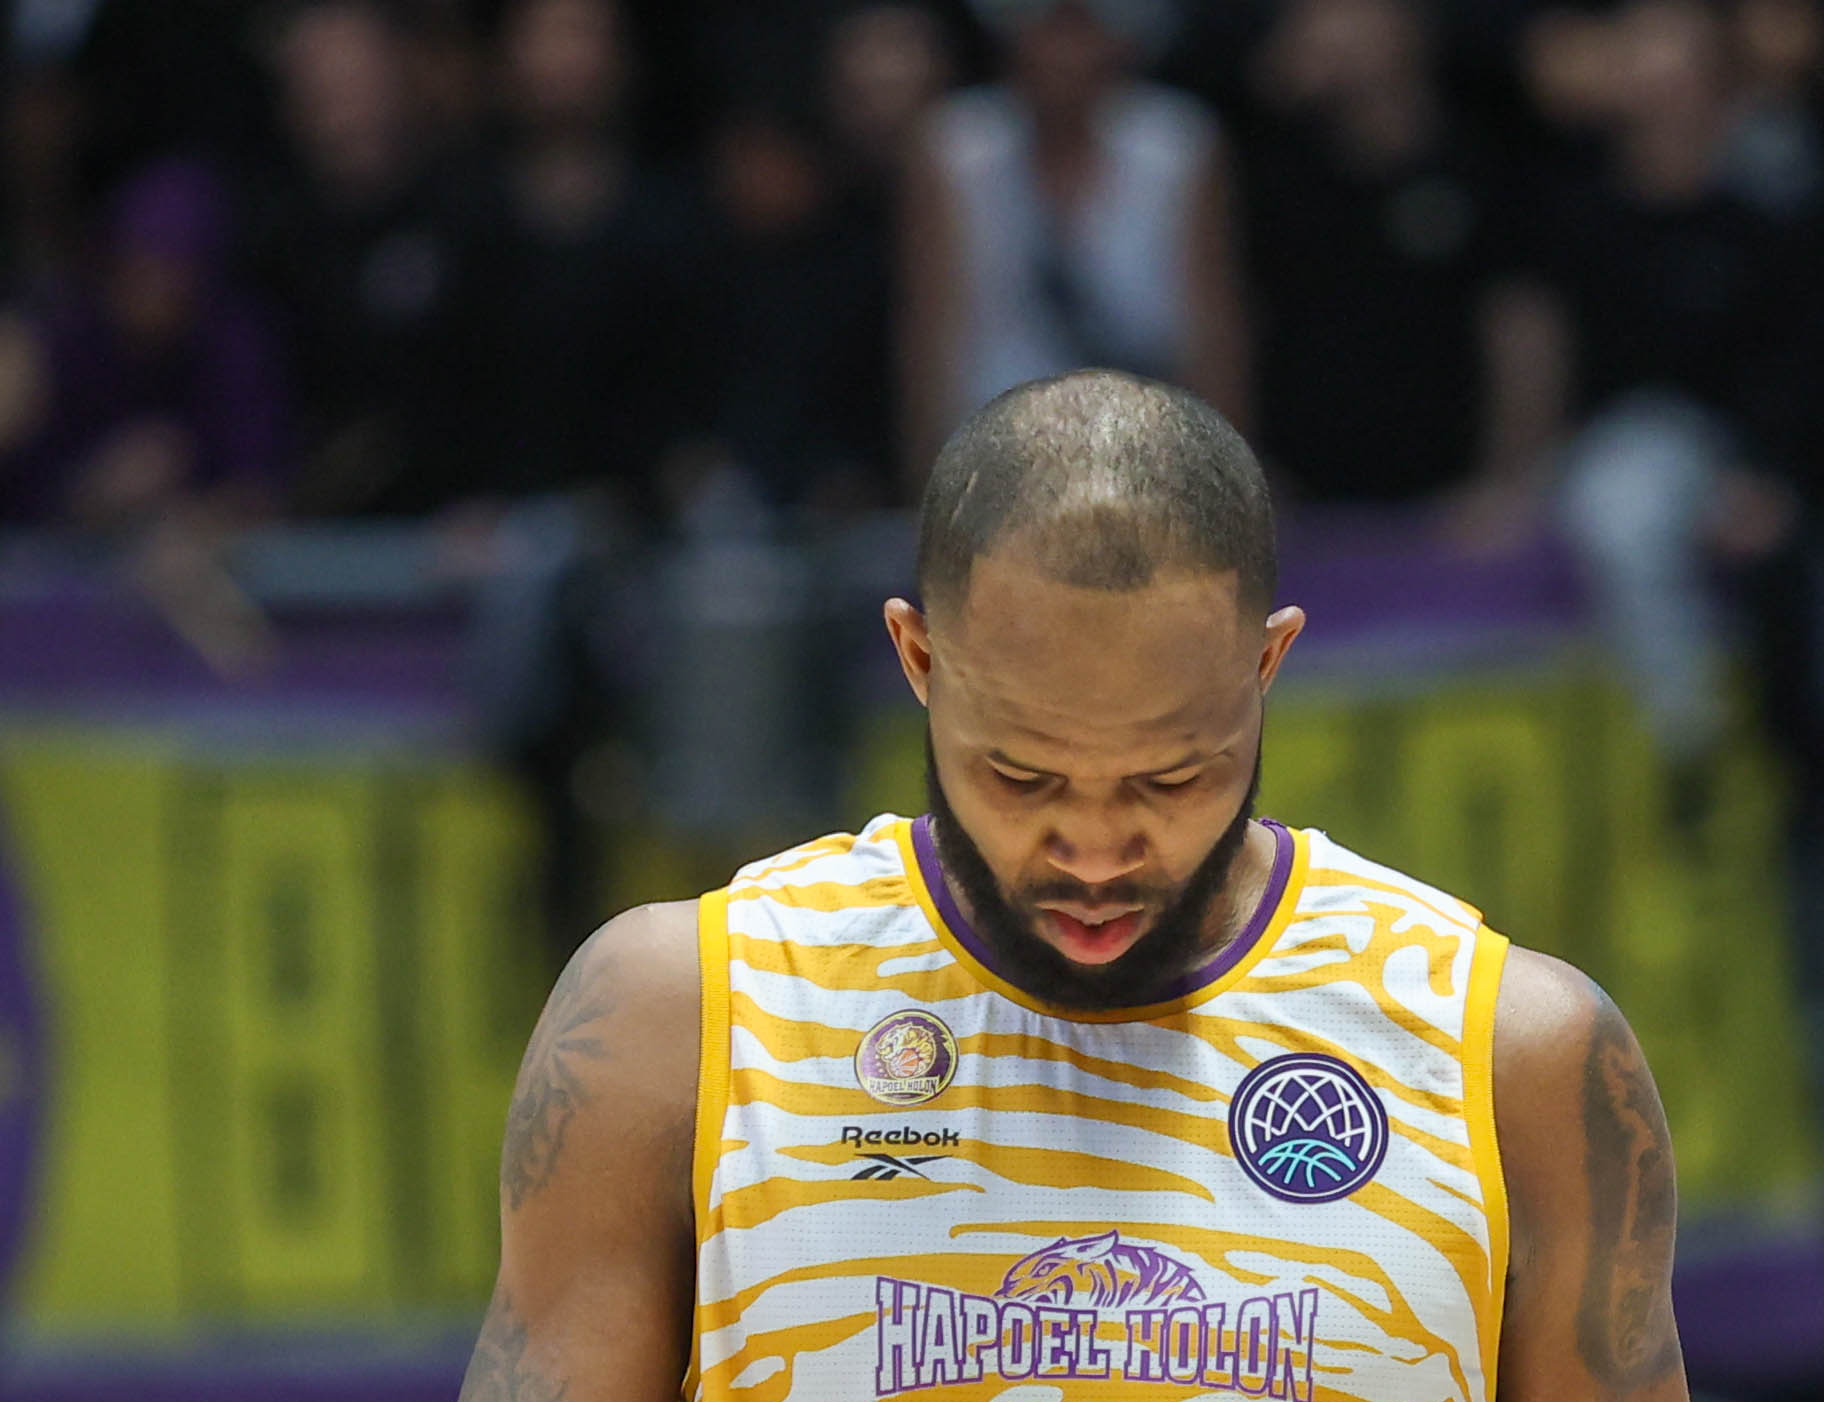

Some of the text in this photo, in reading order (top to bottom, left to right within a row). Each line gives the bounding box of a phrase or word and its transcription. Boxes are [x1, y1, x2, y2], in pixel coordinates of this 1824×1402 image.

[869, 1079, 938, 1094] HAPOEL HOLON
[841, 1126, 960, 1148] Reebok
[875, 1276, 1112, 1396] HAPOEL
